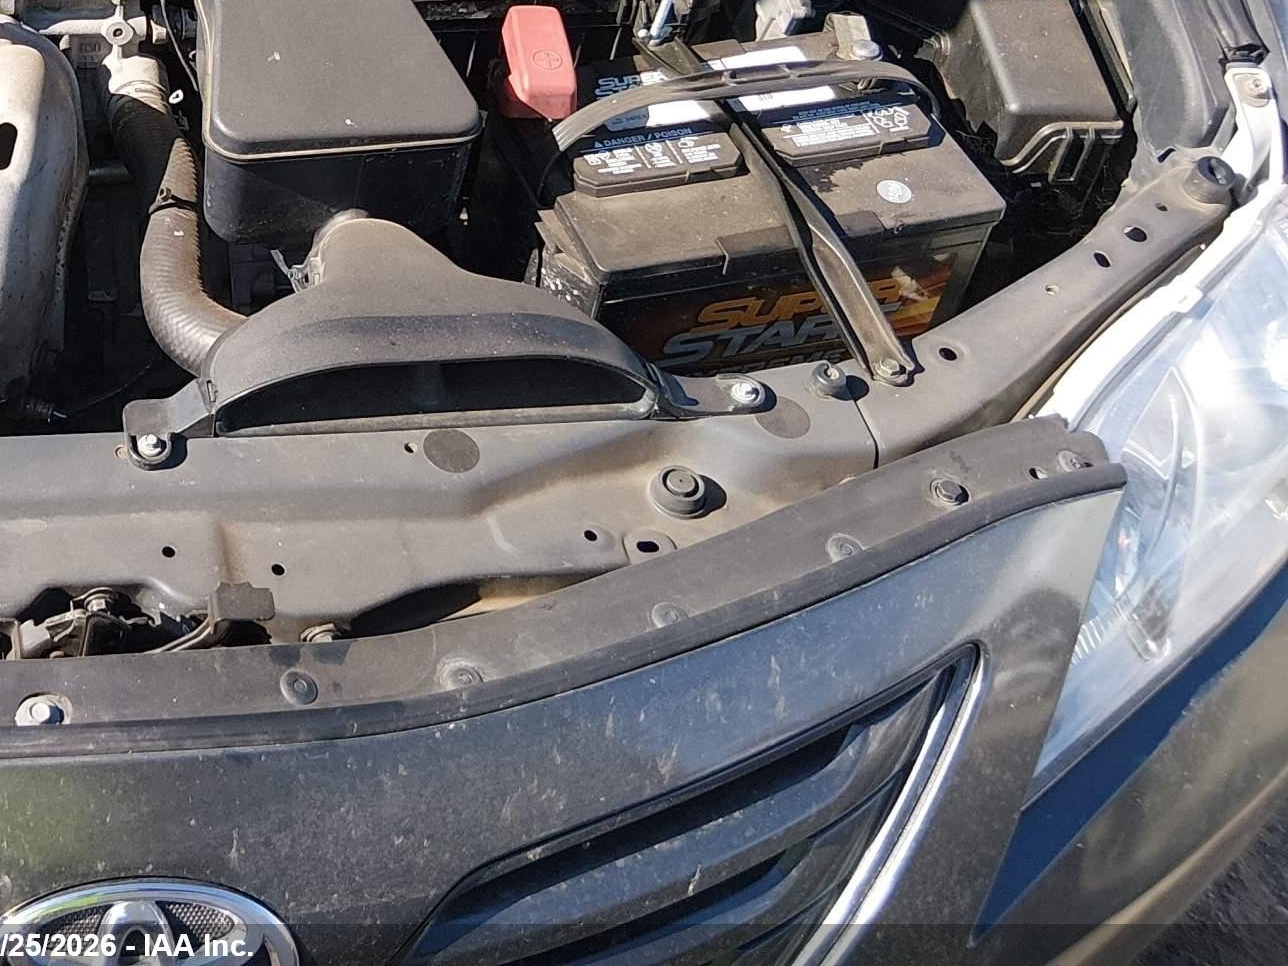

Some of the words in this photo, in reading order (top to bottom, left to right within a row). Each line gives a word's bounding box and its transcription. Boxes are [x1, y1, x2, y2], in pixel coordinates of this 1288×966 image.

[603, 134, 646, 147] DANGER
[654, 127, 693, 139] POISON
[697, 278, 902, 328] SUPR
